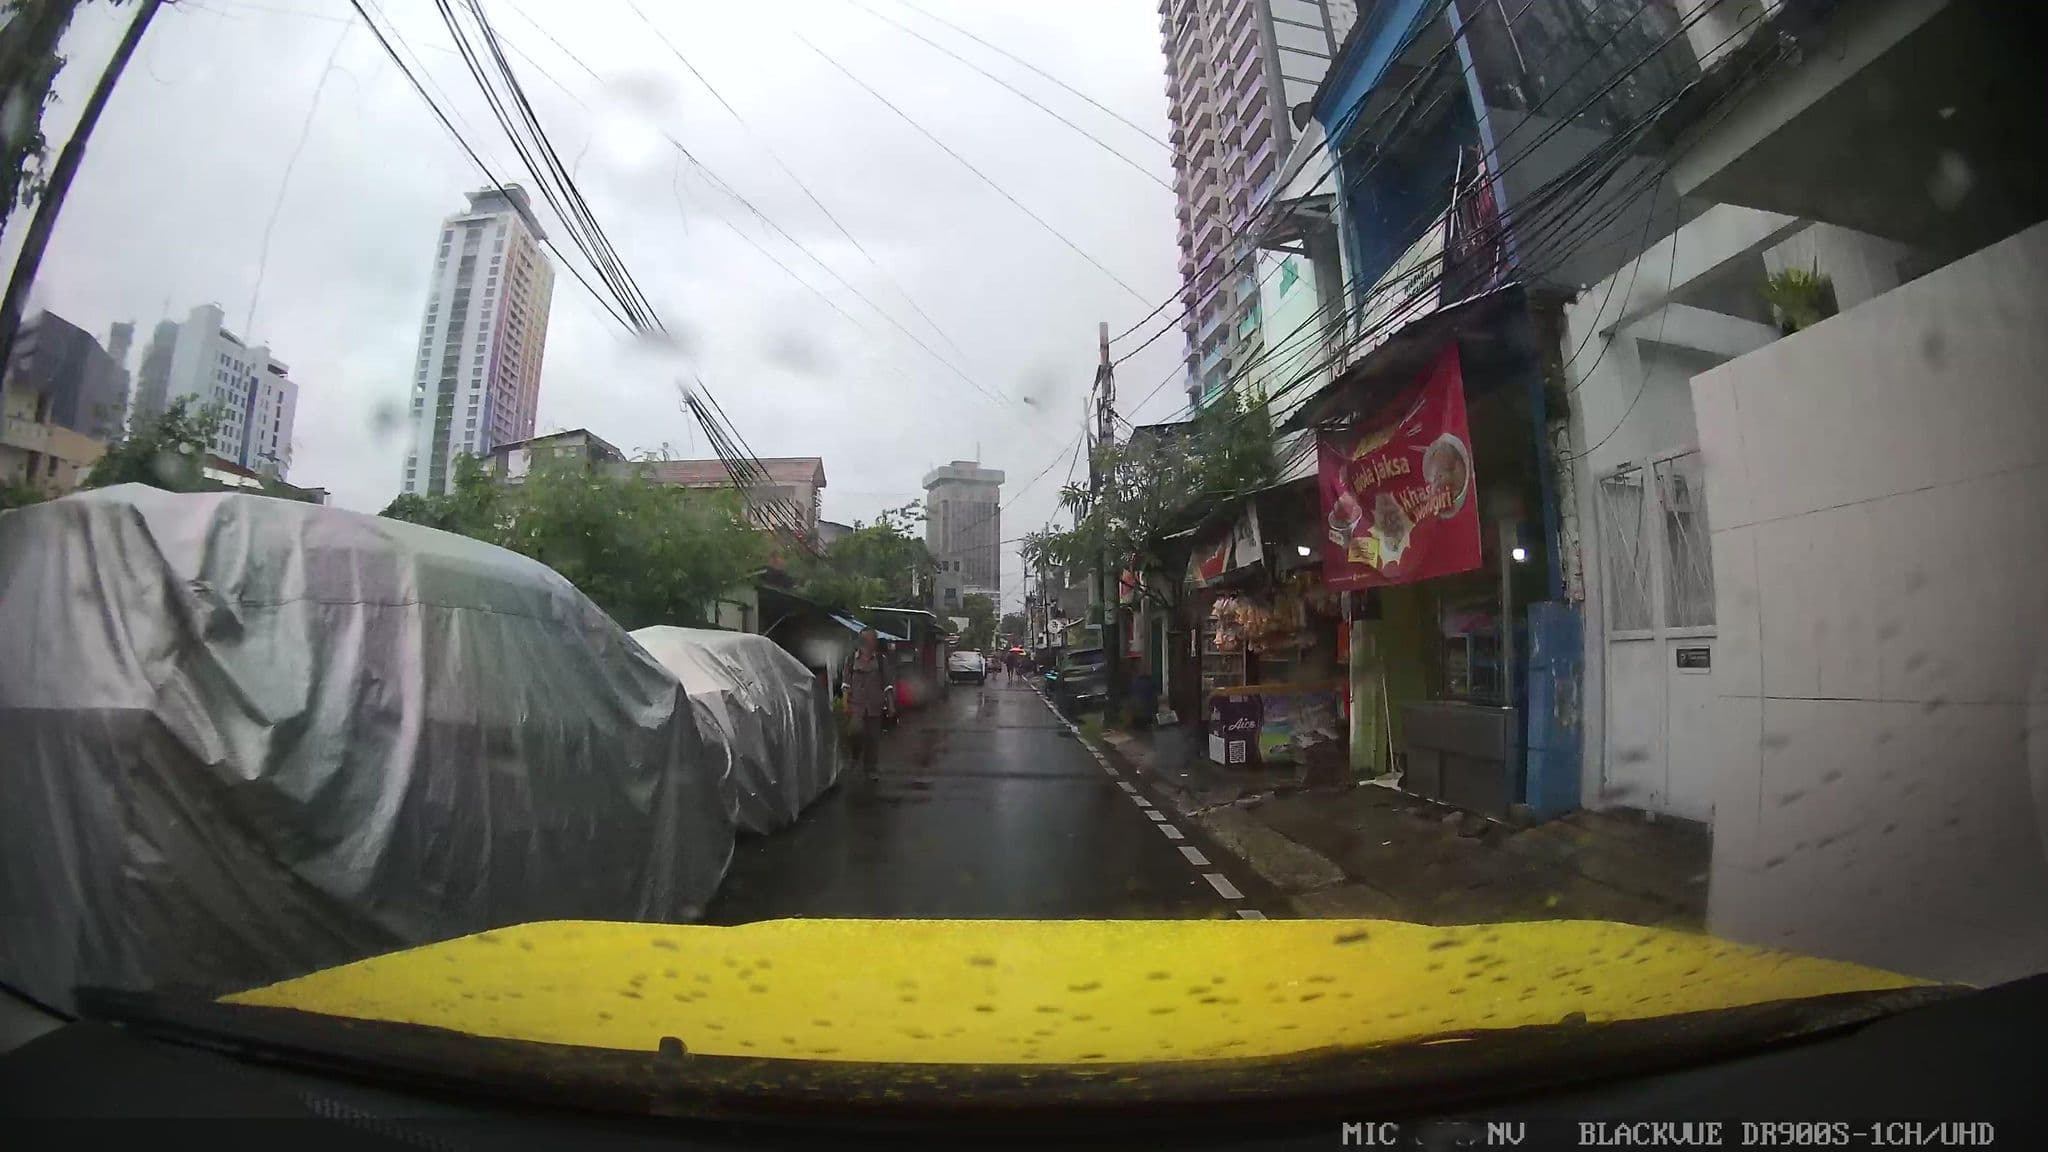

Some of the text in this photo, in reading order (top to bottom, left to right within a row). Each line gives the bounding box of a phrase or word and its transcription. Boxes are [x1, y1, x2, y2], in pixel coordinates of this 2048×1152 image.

[1372, 454, 1411, 487] jaksa
[1399, 485, 1431, 512] Khas
[1229, 717, 1256, 730] Aice
